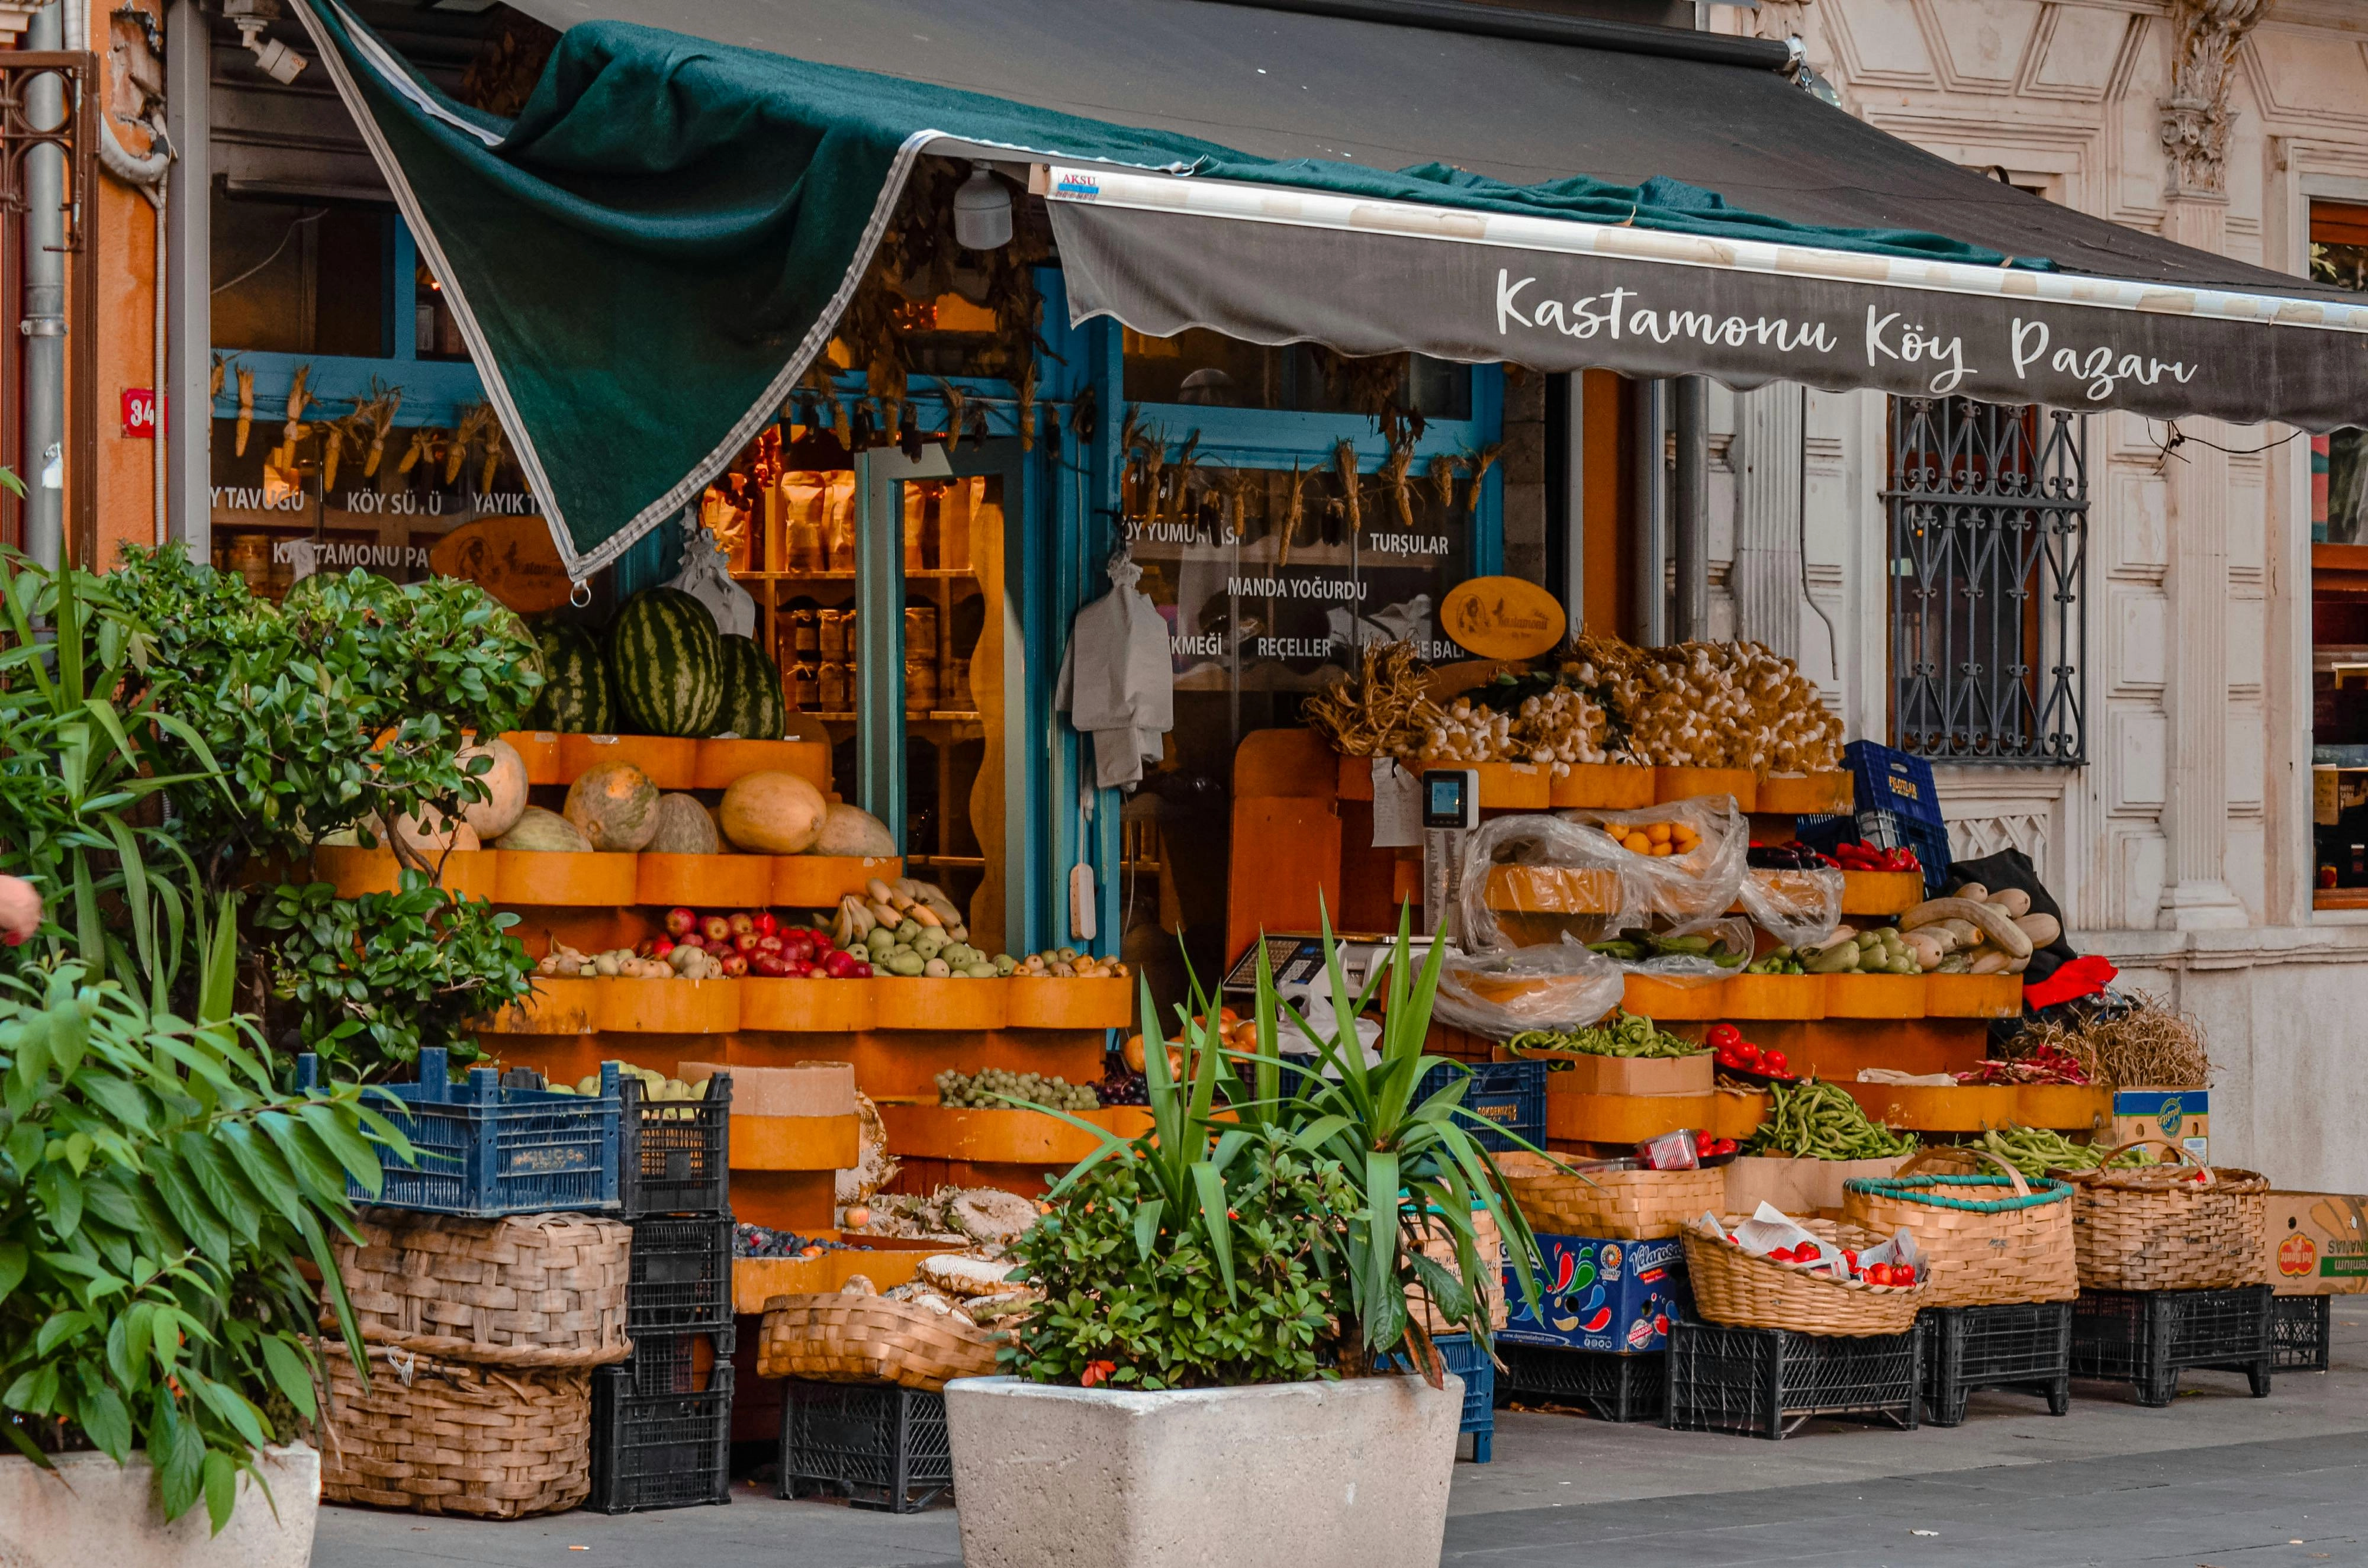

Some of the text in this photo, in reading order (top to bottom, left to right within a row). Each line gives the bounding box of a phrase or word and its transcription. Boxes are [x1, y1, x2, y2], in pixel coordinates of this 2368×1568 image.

[1062, 173, 1096, 186] AKSU
[1496, 268, 2198, 401] Kastamonu Köy Pazarı
[131, 398, 155, 427] 34
[348, 488, 442, 516] KÖY SÜÜ
[473, 492, 524, 514] YAYIK
[1370, 533, 1449, 558] TURŞULAR
[1228, 576, 1367, 600] MANDA YOĞURDU
[1258, 637, 1331, 661] REÇELLER
